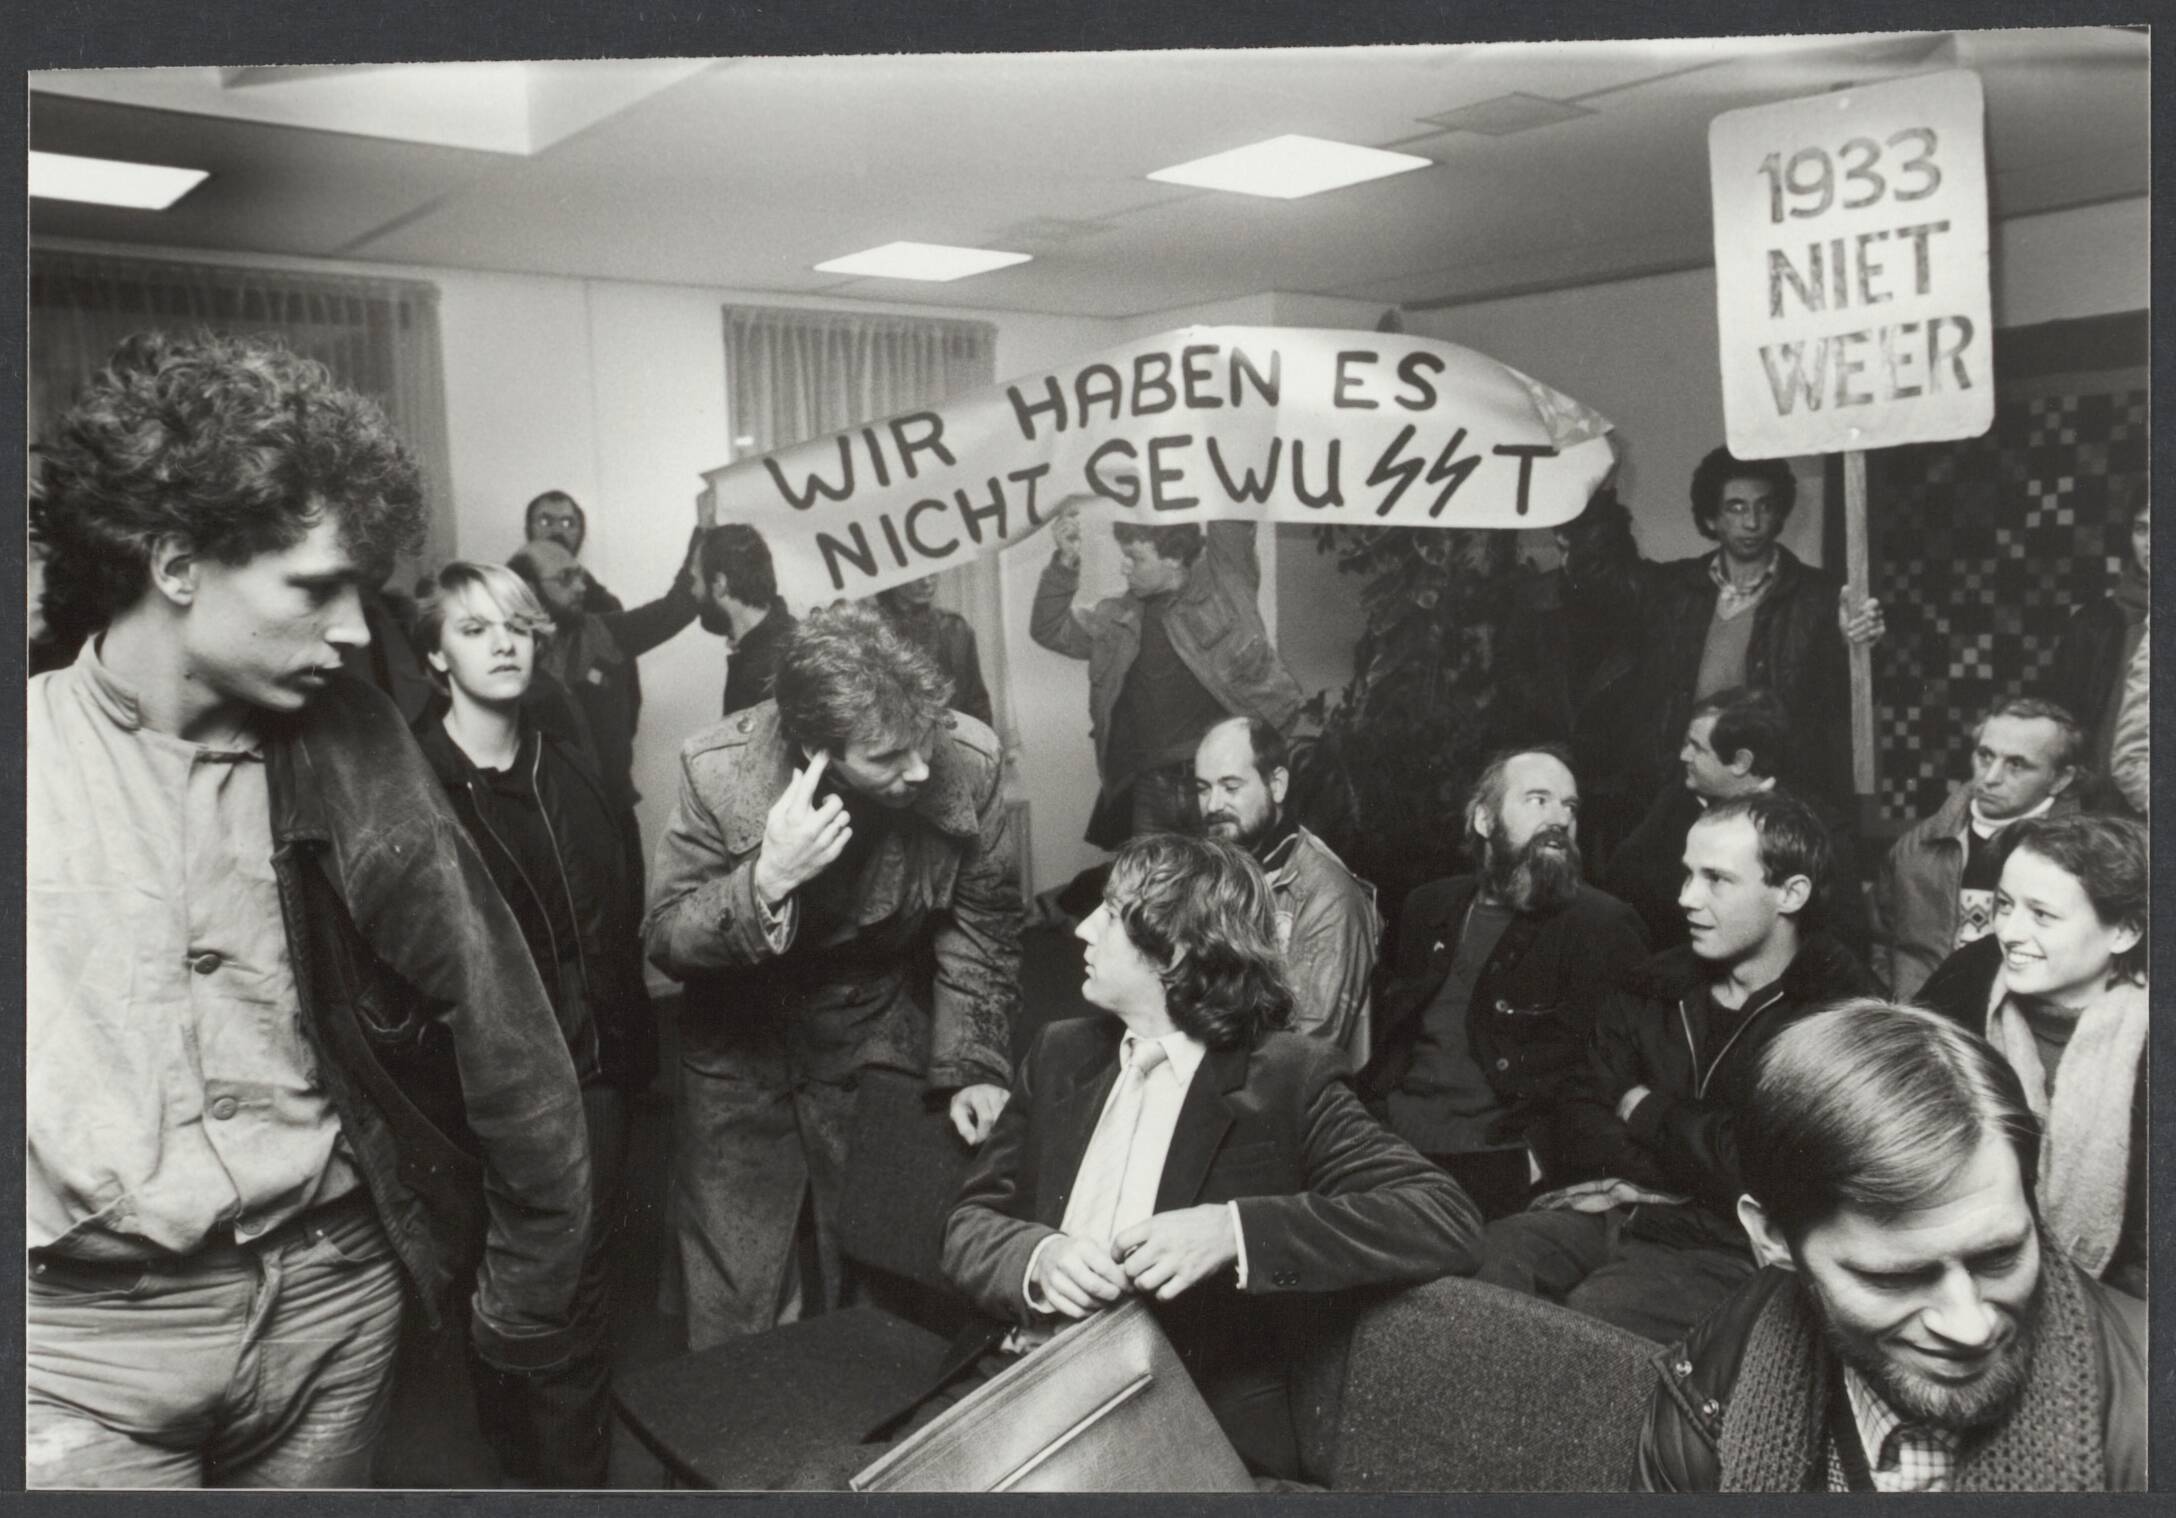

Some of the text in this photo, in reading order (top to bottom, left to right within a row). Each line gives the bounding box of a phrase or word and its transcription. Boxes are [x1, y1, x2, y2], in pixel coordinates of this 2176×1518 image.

[1758, 127, 1942, 223] 1933
[1766, 219, 1950, 319] NIET
[1758, 314, 1974, 416] WEER
[763, 344, 1446, 511] WIR HABEN ES
[815, 462, 1050, 591] NICHT
